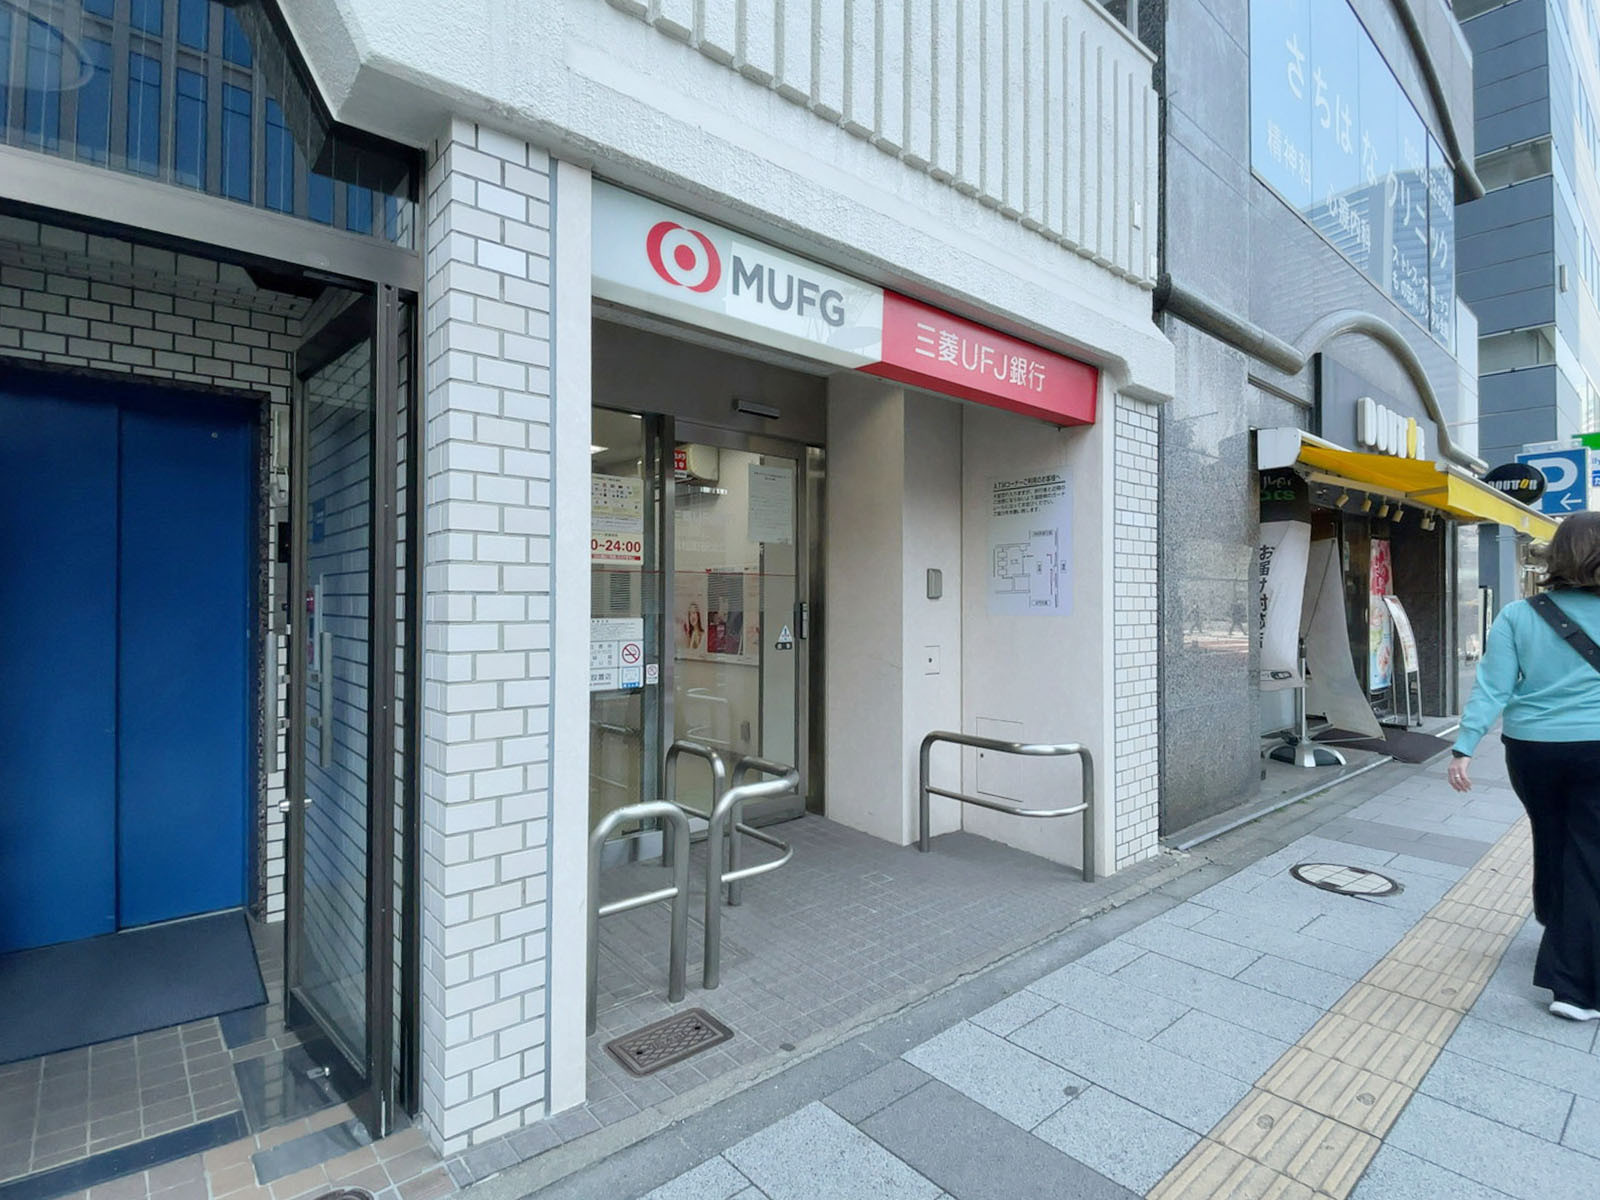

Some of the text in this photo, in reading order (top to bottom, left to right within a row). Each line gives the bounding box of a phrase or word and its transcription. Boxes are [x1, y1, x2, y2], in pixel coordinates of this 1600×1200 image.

[731, 255, 846, 327] MUFG
[914, 322, 1047, 393] 三菱UFJ銀行
